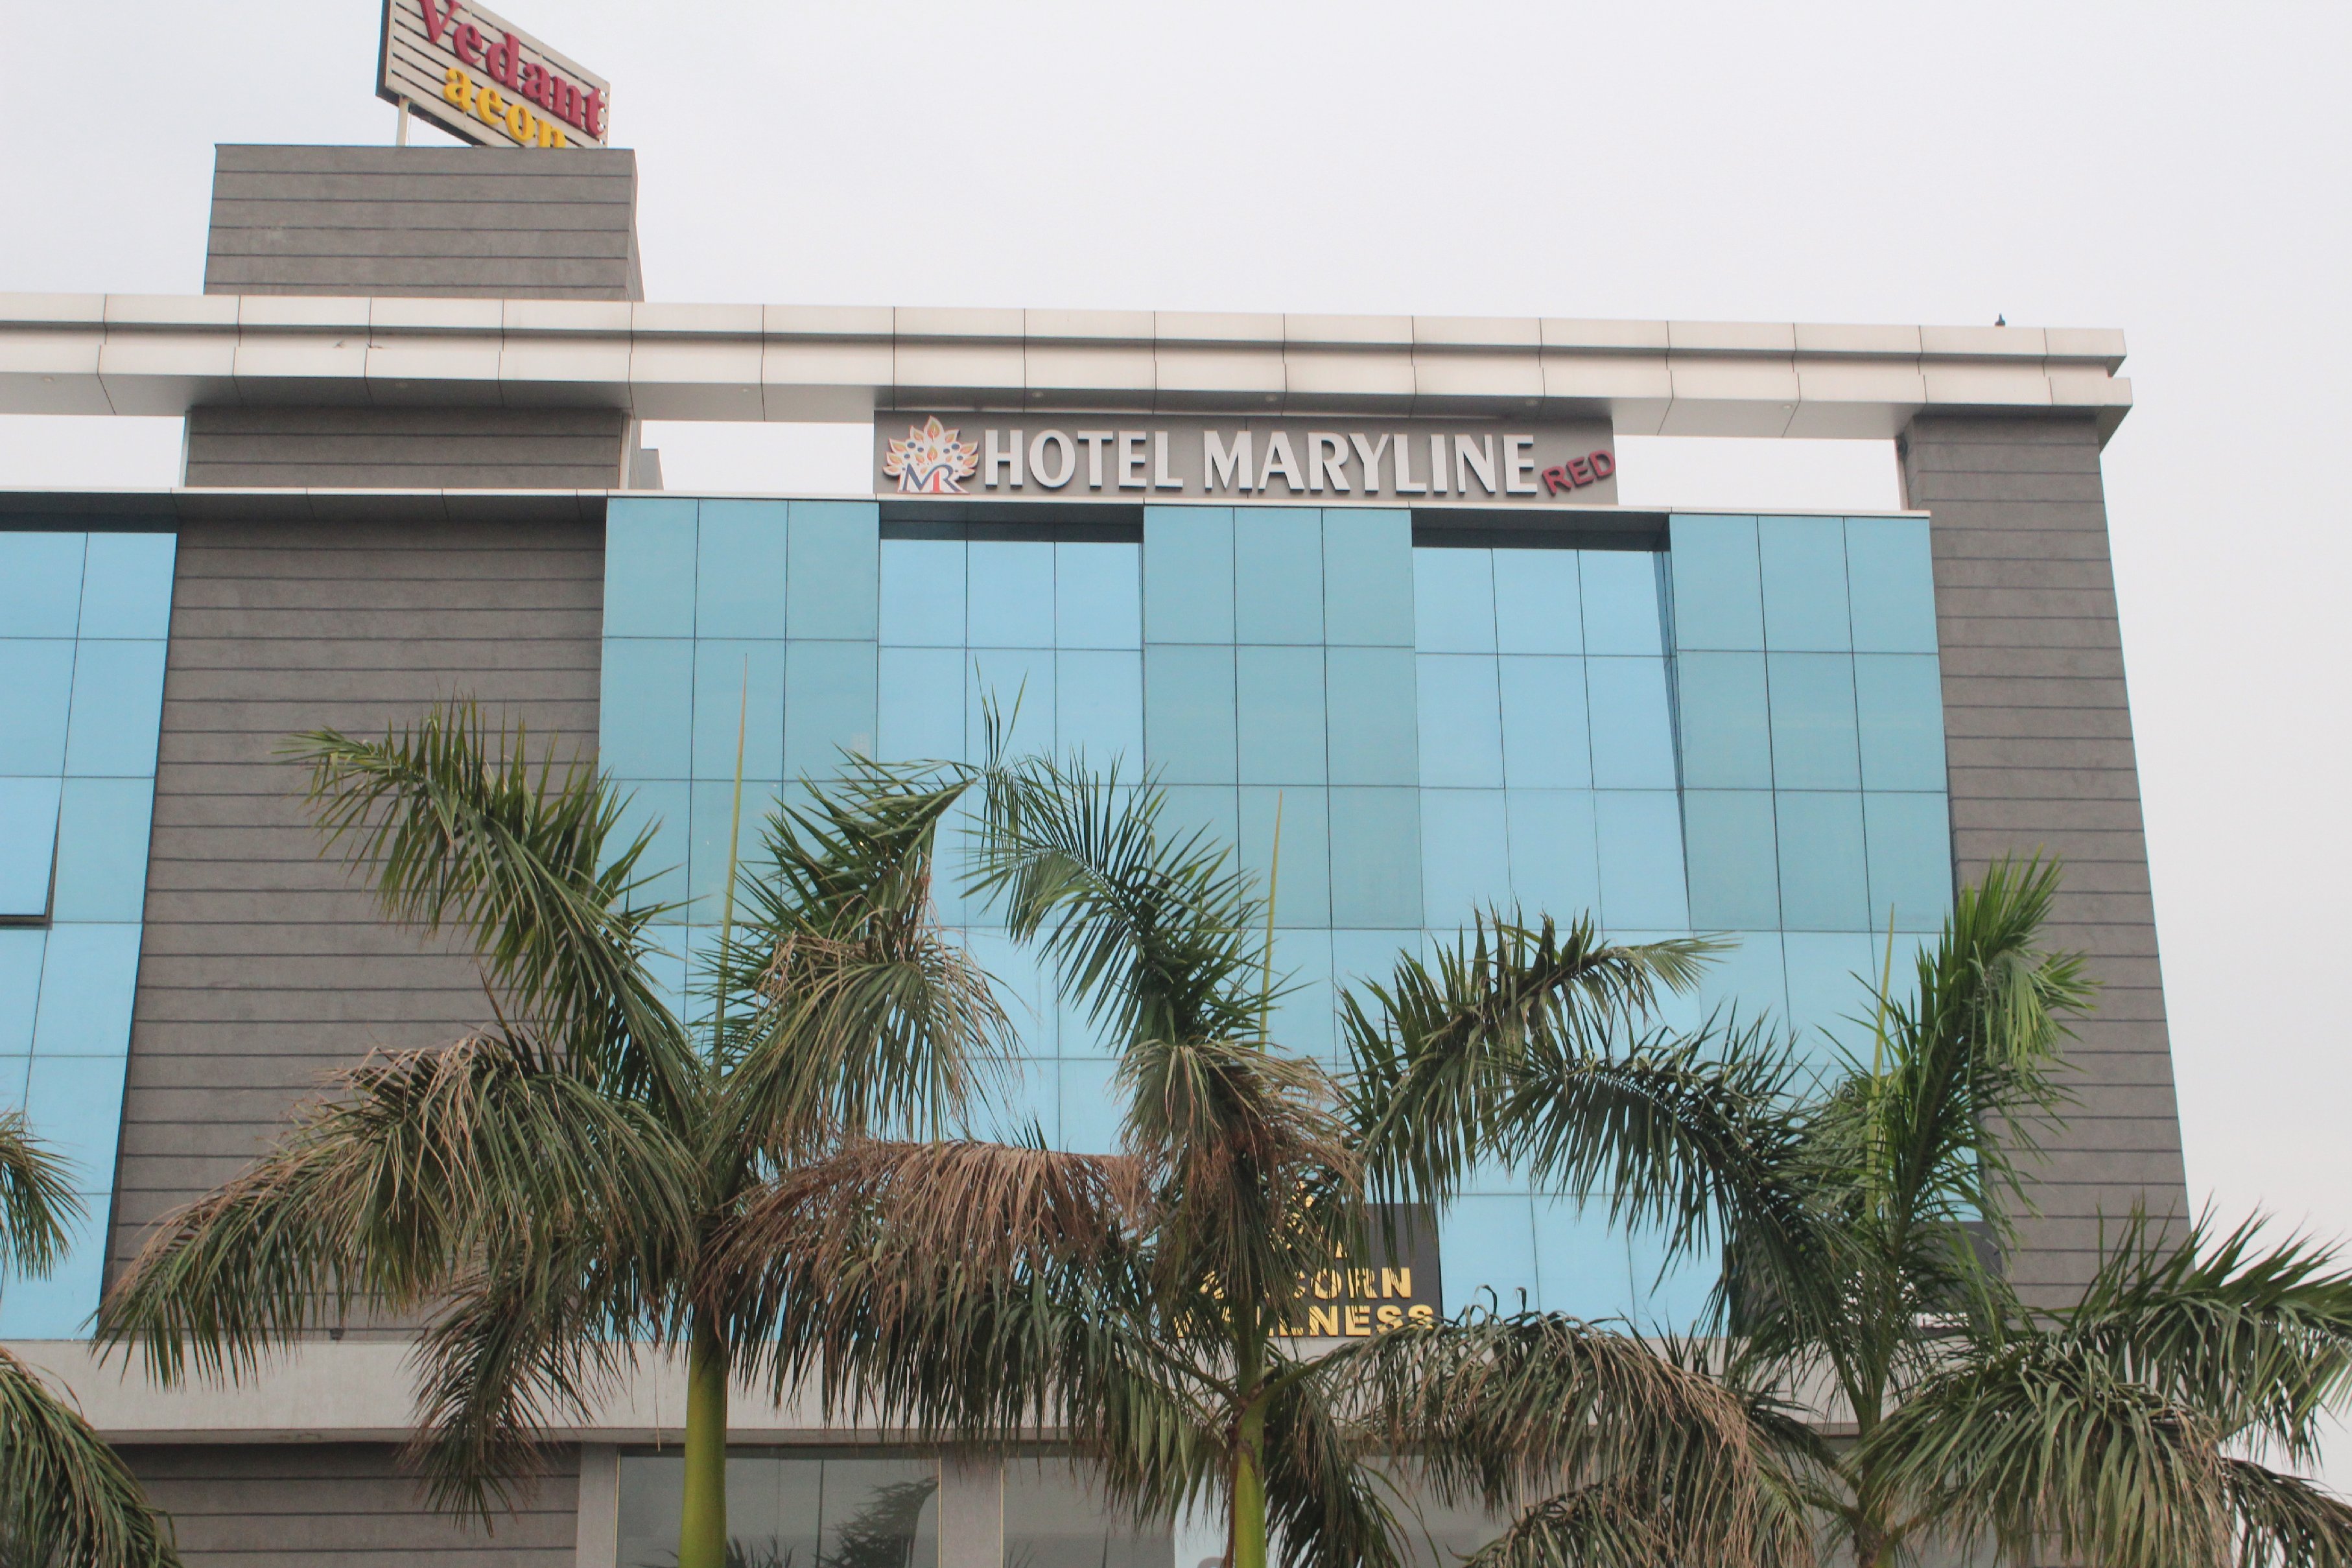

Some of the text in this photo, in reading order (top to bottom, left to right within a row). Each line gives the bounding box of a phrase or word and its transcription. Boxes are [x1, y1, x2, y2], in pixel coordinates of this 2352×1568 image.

[418, 0, 606, 136] Vedant
[443, 67, 567, 148] aeon
[985, 429, 1538, 494] HOTEL MARYLINE
[1542, 450, 1616, 496] RED
